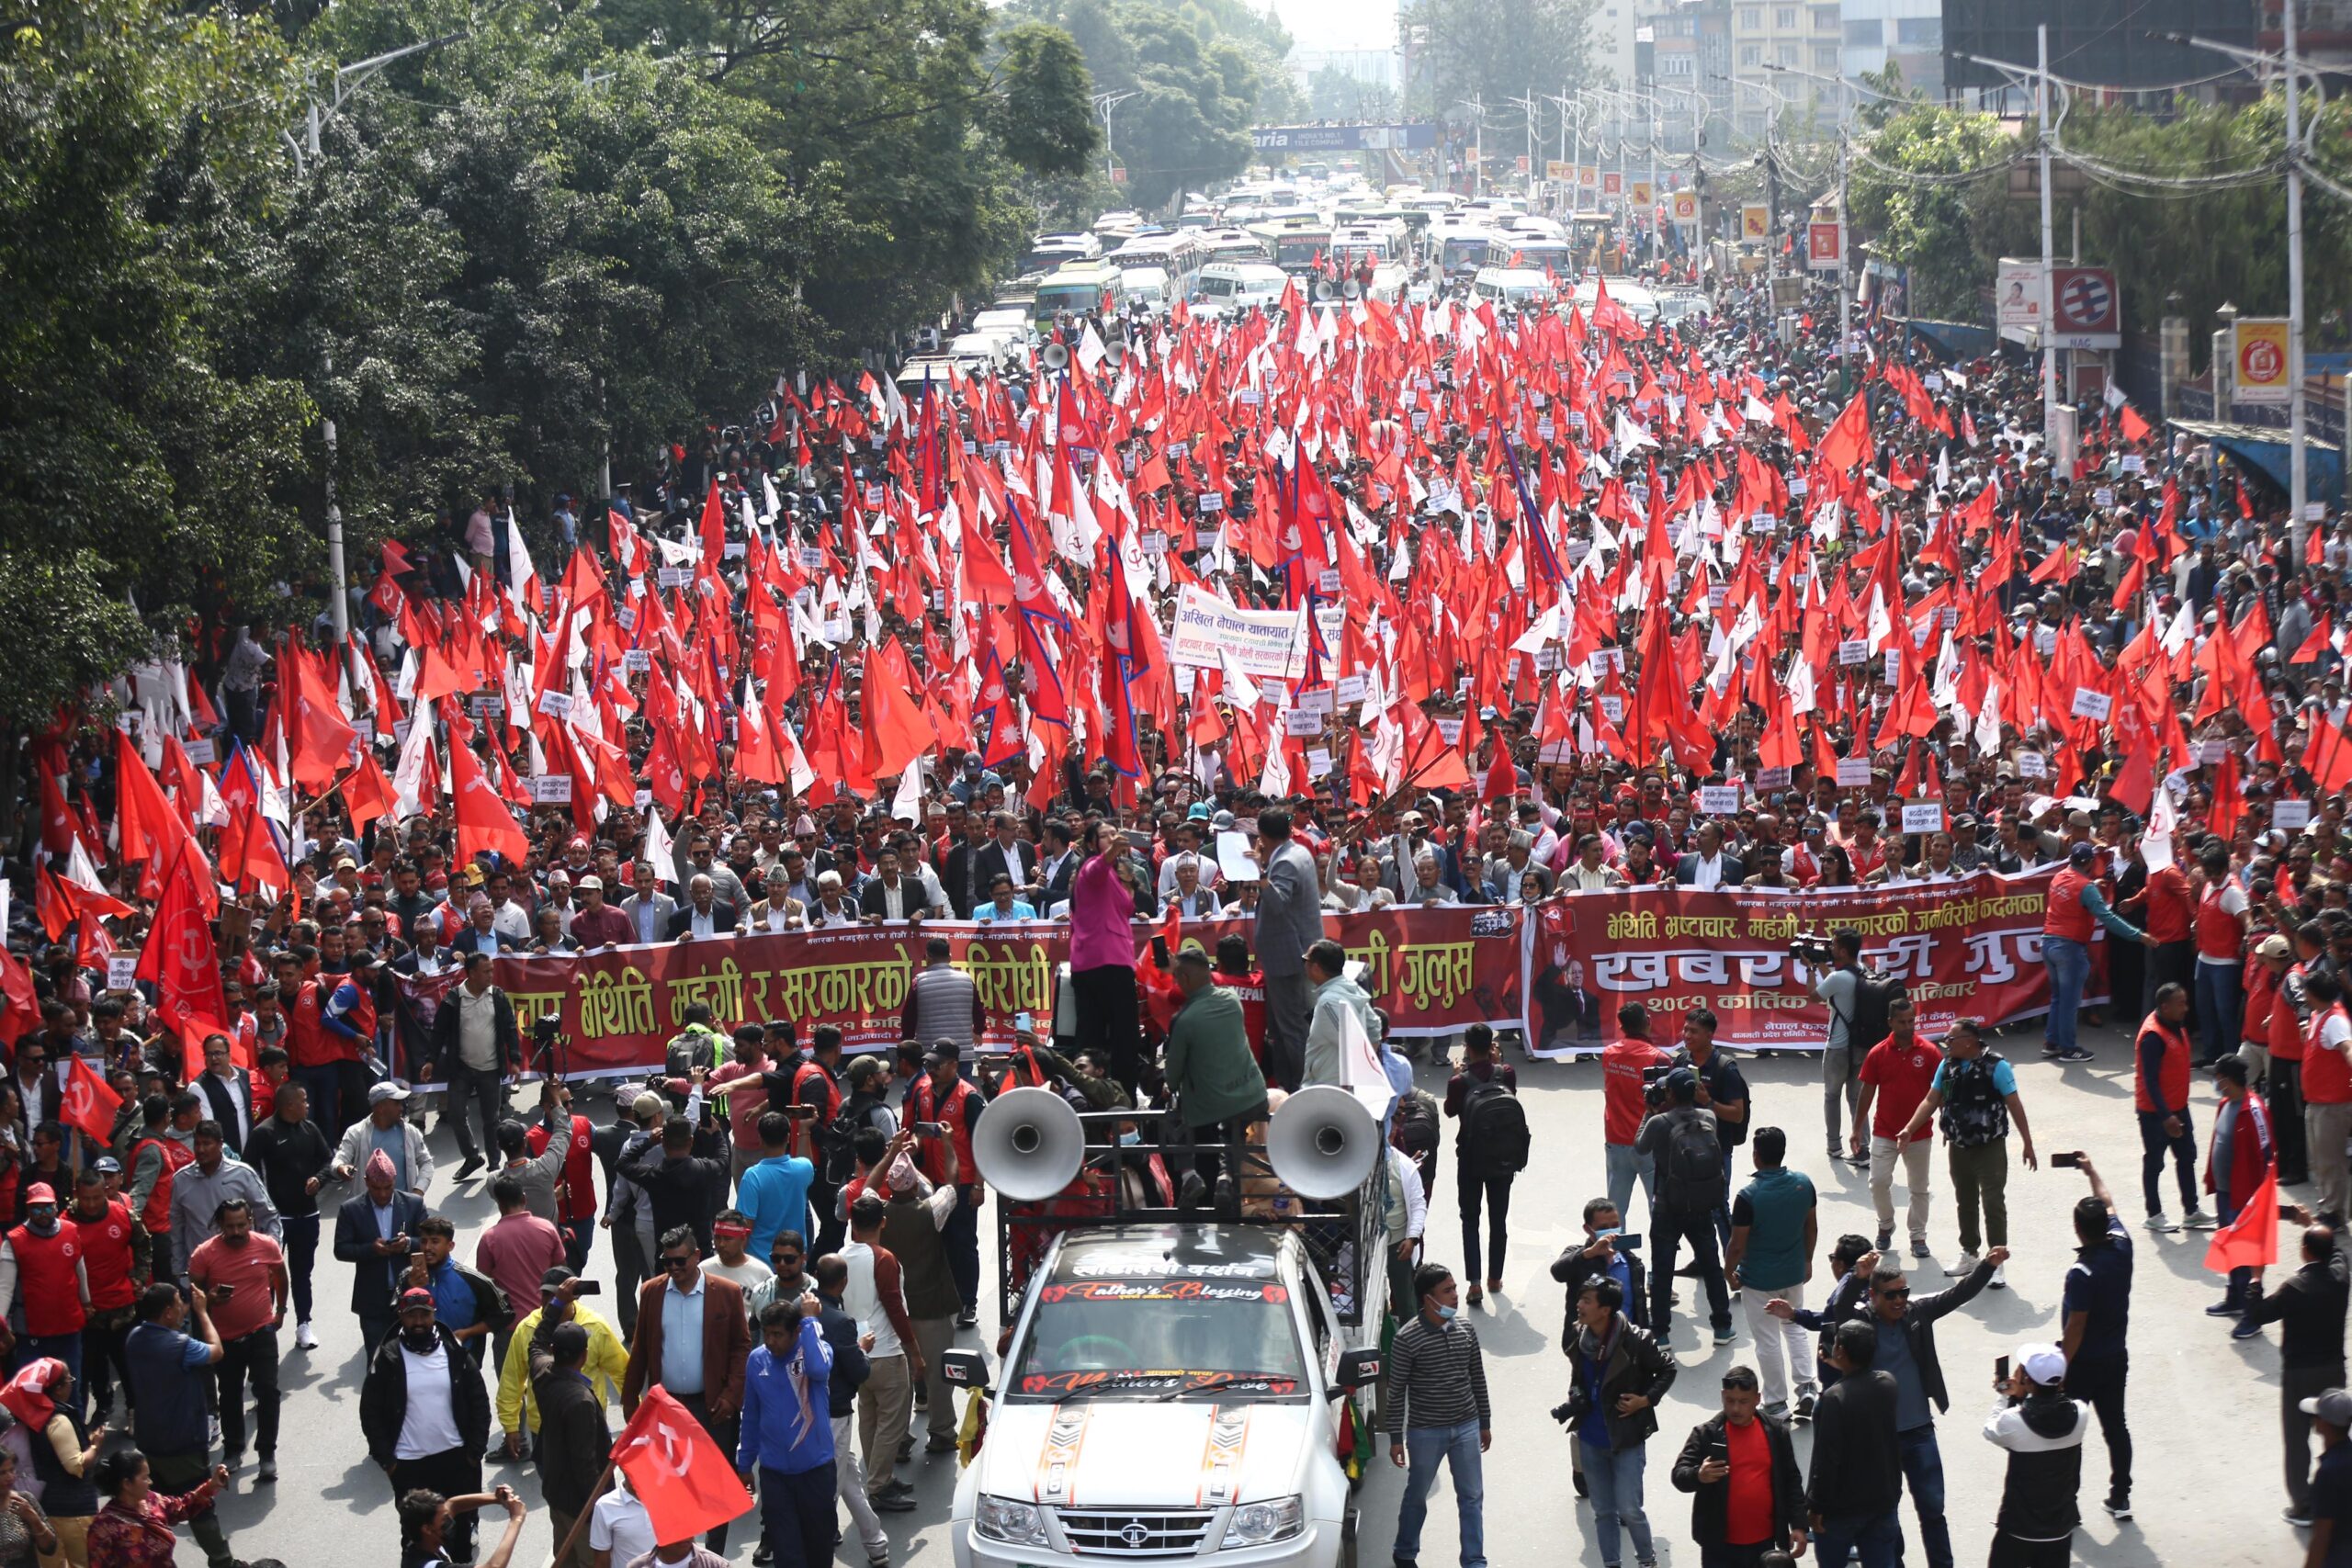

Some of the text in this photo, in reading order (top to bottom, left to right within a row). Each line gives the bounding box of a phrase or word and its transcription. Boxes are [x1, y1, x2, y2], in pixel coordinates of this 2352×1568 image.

[1181, 608, 1213, 627] अखिल
[1217, 614, 1245, 633] नेपाल
[1248, 624, 1289, 639] यातायात
[751, 971, 773, 1023] र
[780, 942, 912, 1023] सरकारको
[1397, 941, 1476, 1010] जुलुस
[1647, 995, 1707, 1012] २०८१
[1765, 1021, 1798, 1030] नेपाल
[1066, 1280, 1263, 1301] Father's Blessing
